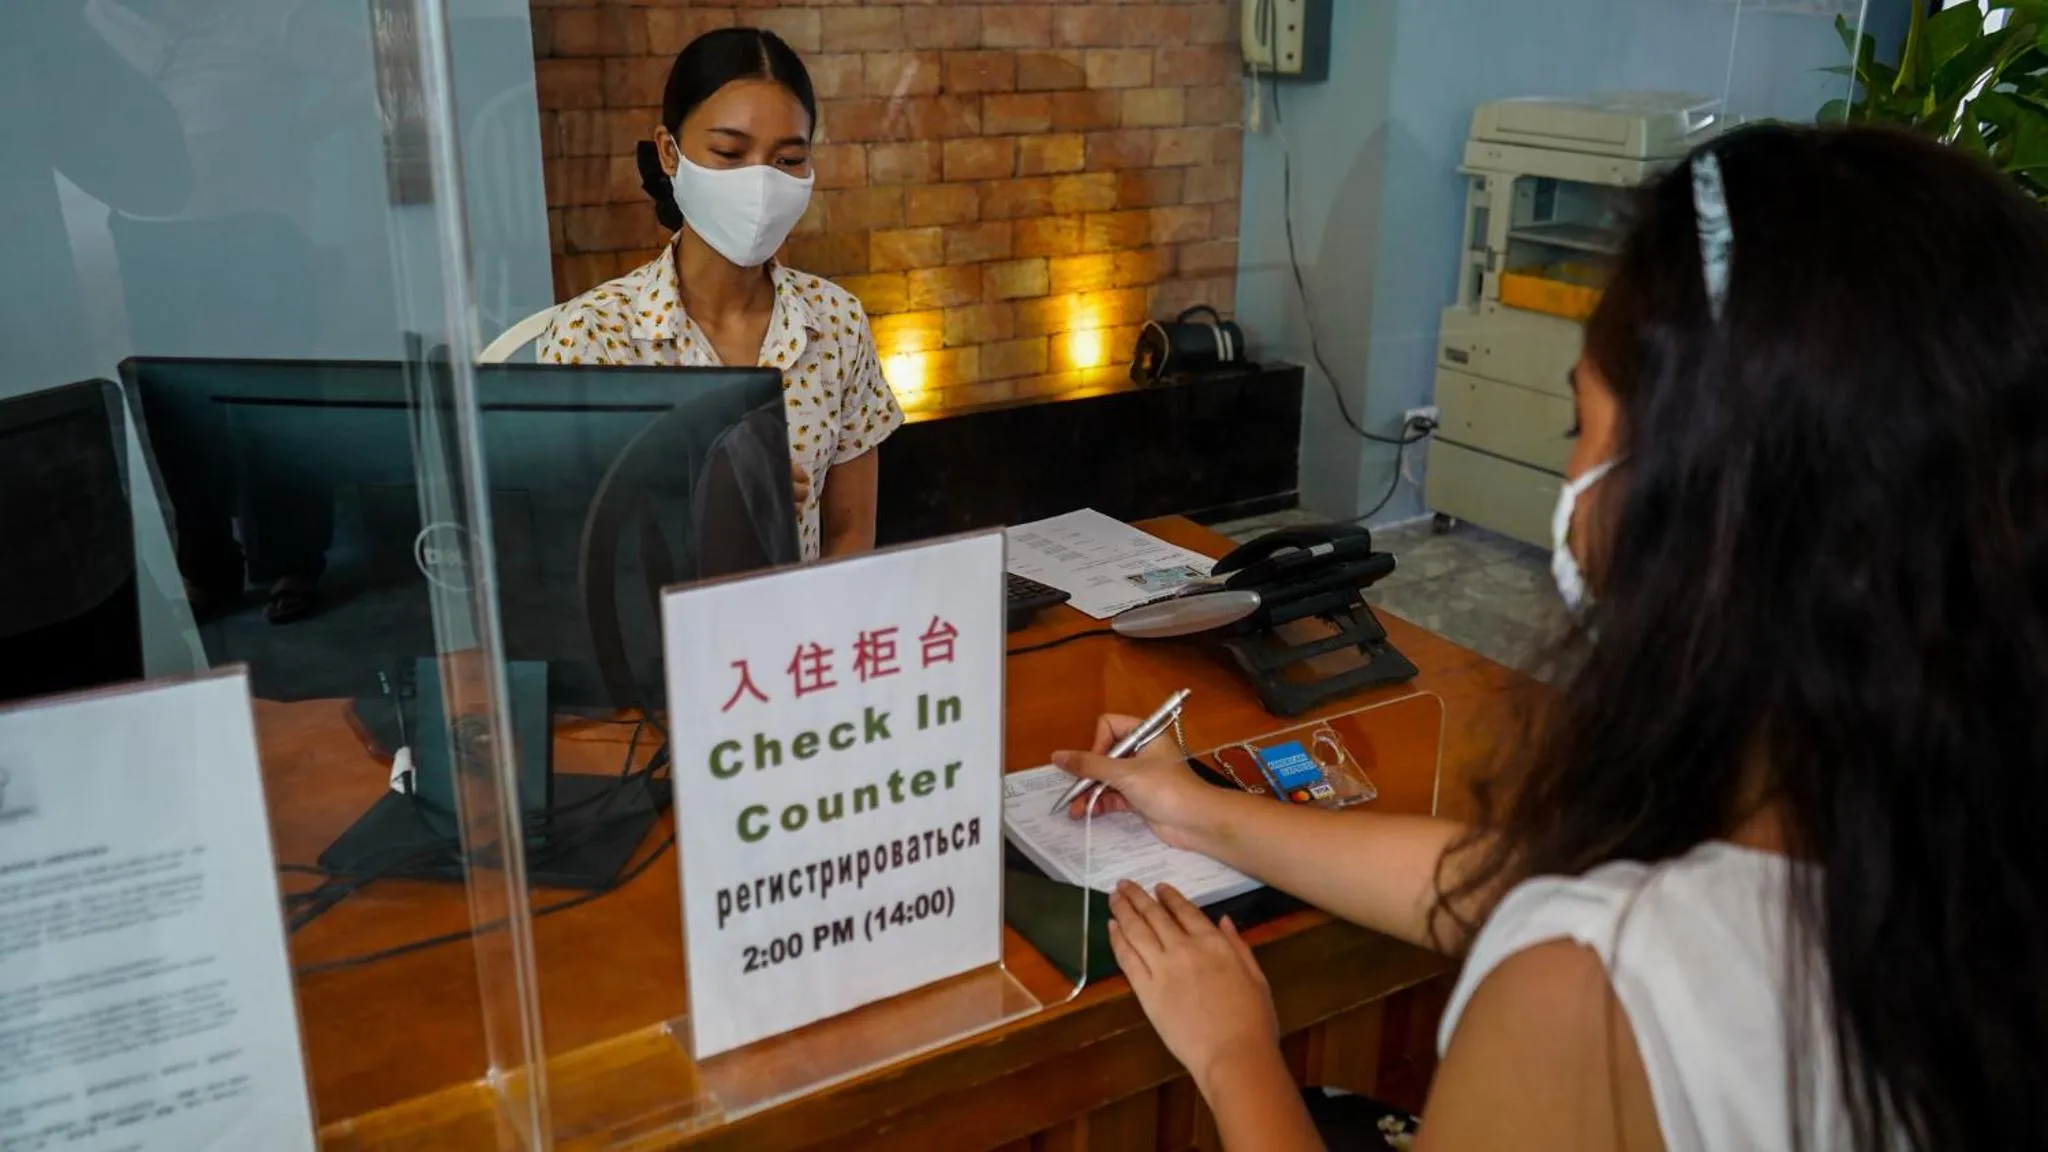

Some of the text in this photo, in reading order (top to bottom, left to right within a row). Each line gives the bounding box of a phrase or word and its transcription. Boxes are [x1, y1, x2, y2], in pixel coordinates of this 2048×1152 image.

[721, 615, 959, 713] 入住柜台
[708, 693, 962, 780] Check In
[736, 760, 963, 844] Counter
[716, 816, 981, 930] регистрироваться
[742, 885, 956, 975] 2:00 PM (14:00)
